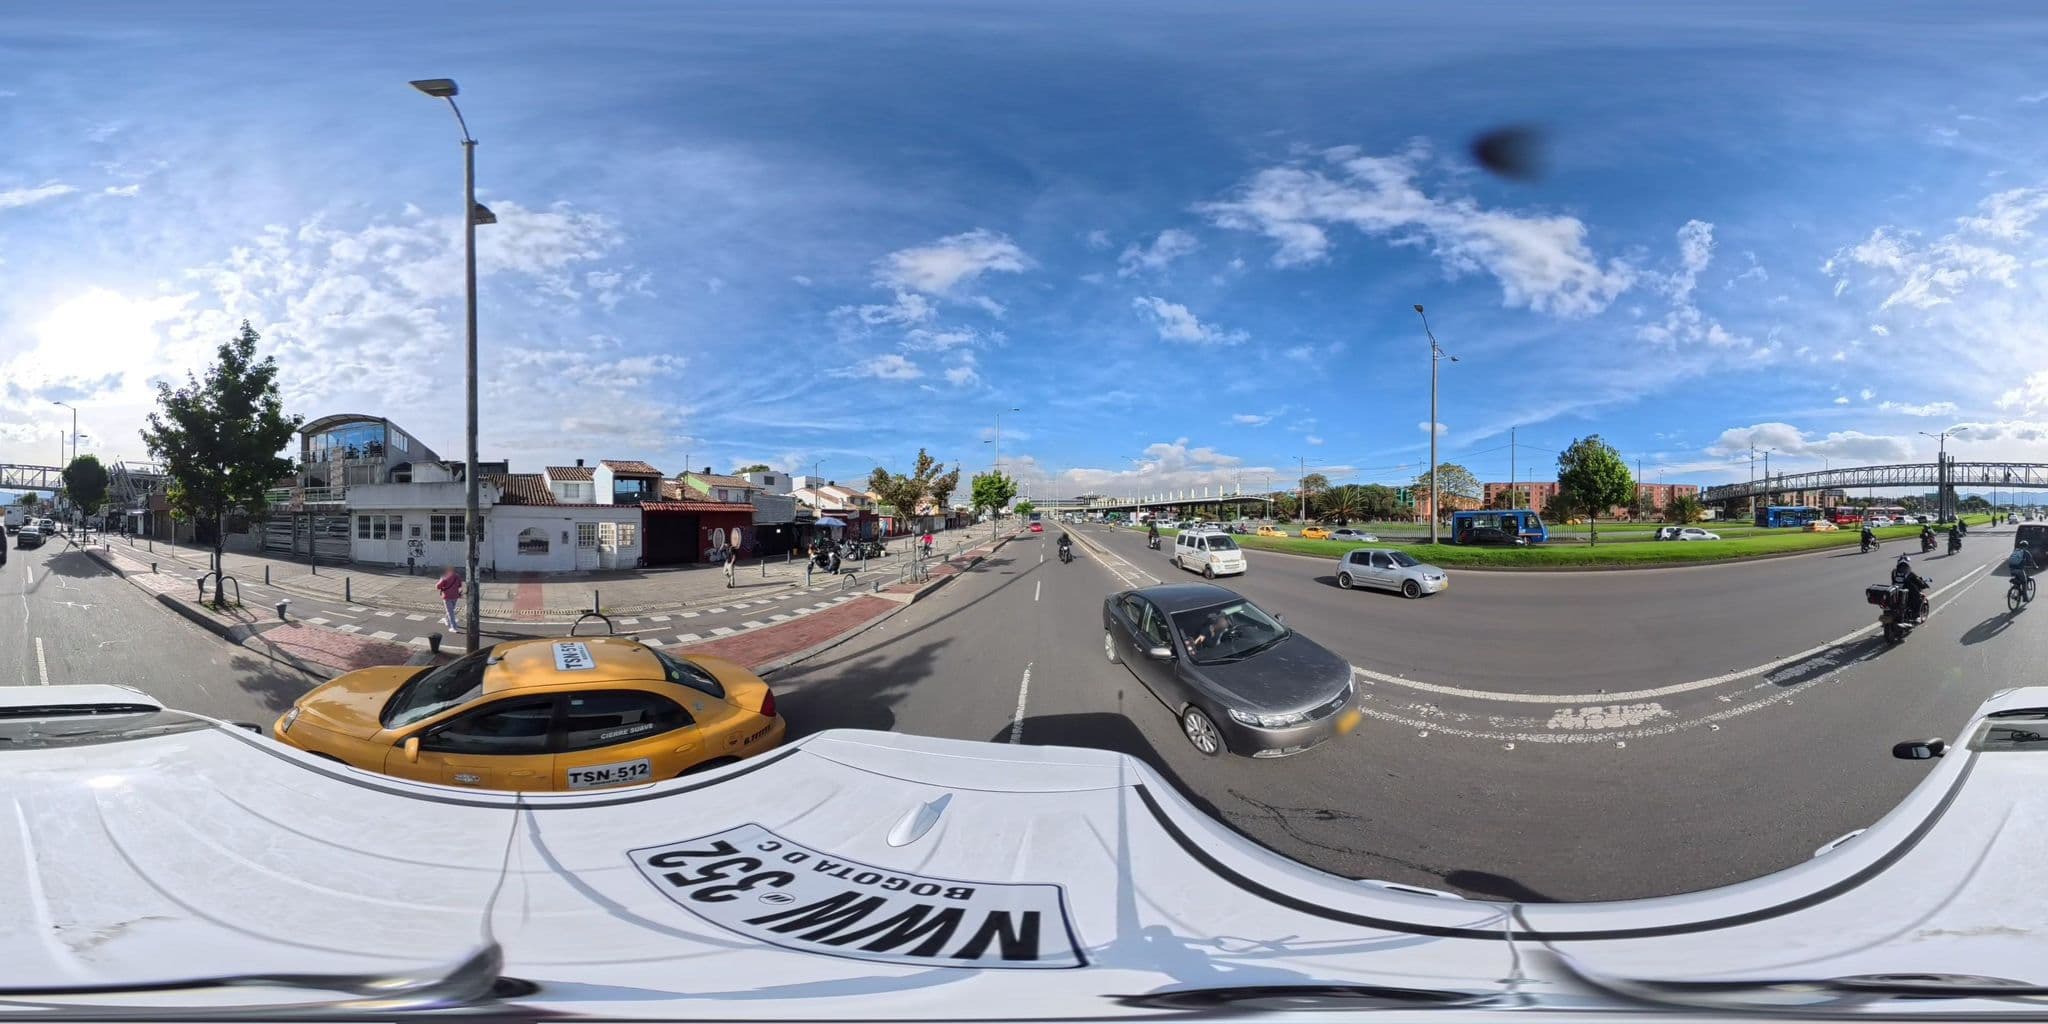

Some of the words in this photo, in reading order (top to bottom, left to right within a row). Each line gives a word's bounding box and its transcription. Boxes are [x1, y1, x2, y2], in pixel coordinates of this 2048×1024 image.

[629, 723, 654, 735] SUAVE
[569, 763, 648, 783] TSN-512
[757, 841, 782, 852] C
[782, 851, 811, 864] D
[647, 840, 795, 902] 352
[812, 860, 976, 900] BOGOTA
[741, 890, 1041, 961] NWW
